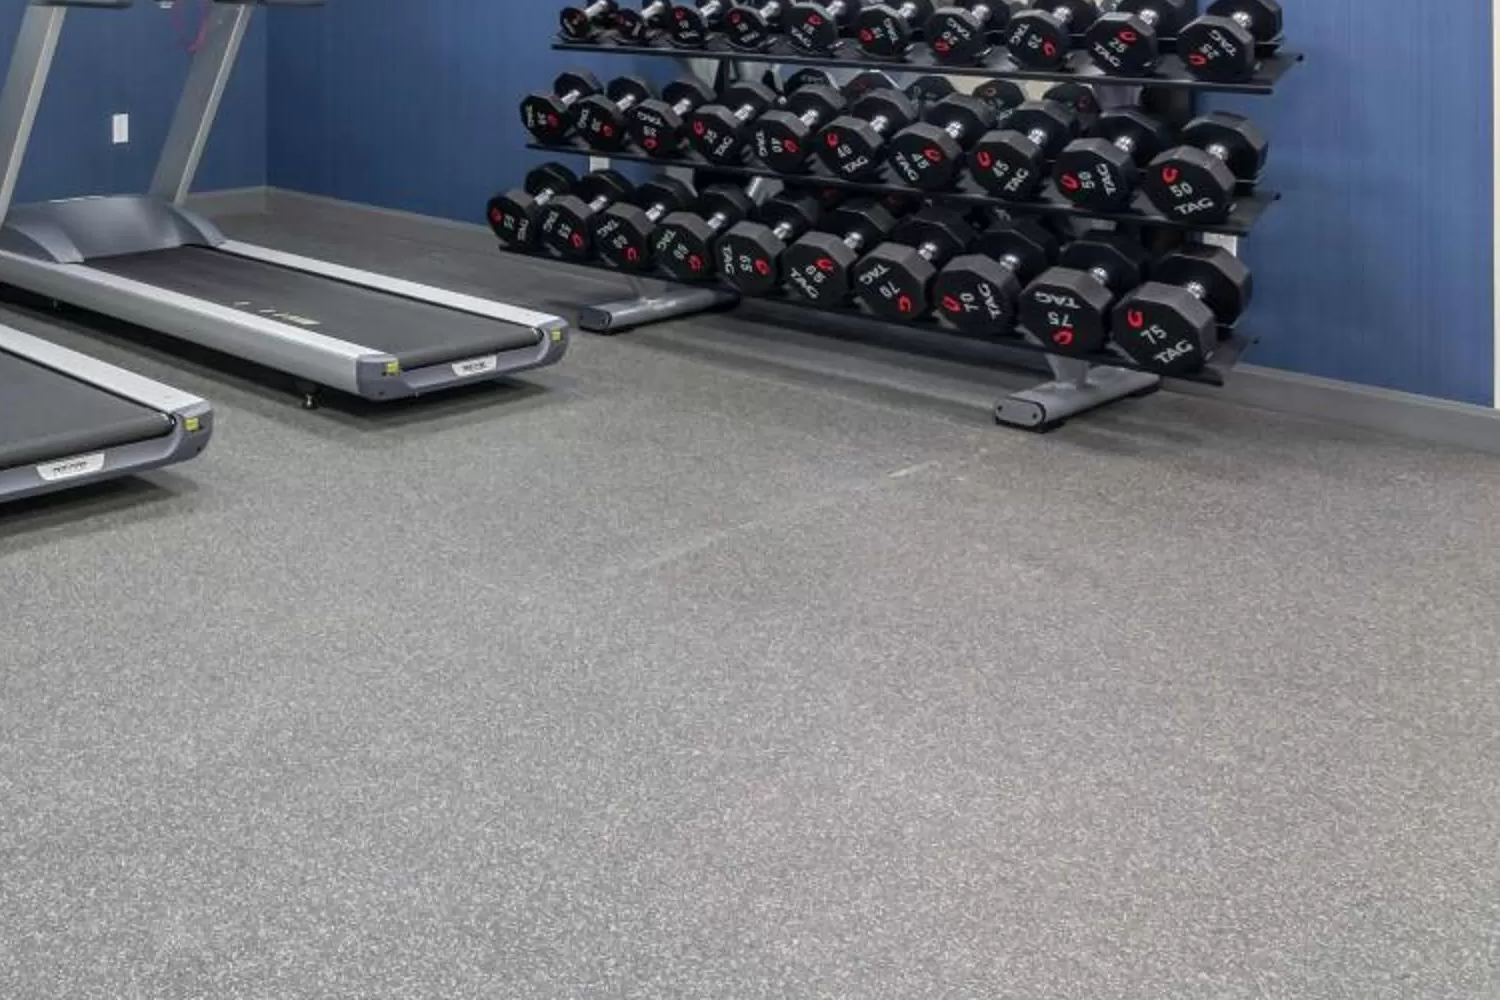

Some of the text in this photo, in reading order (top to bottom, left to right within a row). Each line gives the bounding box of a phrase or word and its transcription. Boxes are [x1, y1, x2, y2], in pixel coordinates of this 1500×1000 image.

[1209, 29, 1236, 57] TAG
[1092, 41, 1121, 68] TAG
[841, 156, 868, 173] TAG
[895, 151, 919, 180] TAG
[992, 160, 1009, 177] 45
[1003, 168, 1029, 192] TAG
[1077, 171, 1095, 189] 50
[1095, 163, 1117, 196] TAG
[1169, 181, 1193, 197] 50
[1173, 197, 1214, 215] TAG
[656, 229, 677, 251] TAG
[722, 243, 735, 275] TAG
[790, 267, 820, 299] TAG
[859, 264, 891, 285] TAG
[879, 281, 900, 298] 70
[1034, 291, 1082, 309] TAG
[959, 292, 979, 312] 70
[977, 283, 1002, 320] TAG
[1047, 311, 1074, 328] 75
[1140, 324, 1167, 345] 75
[1152, 340, 1194, 364] TAG
